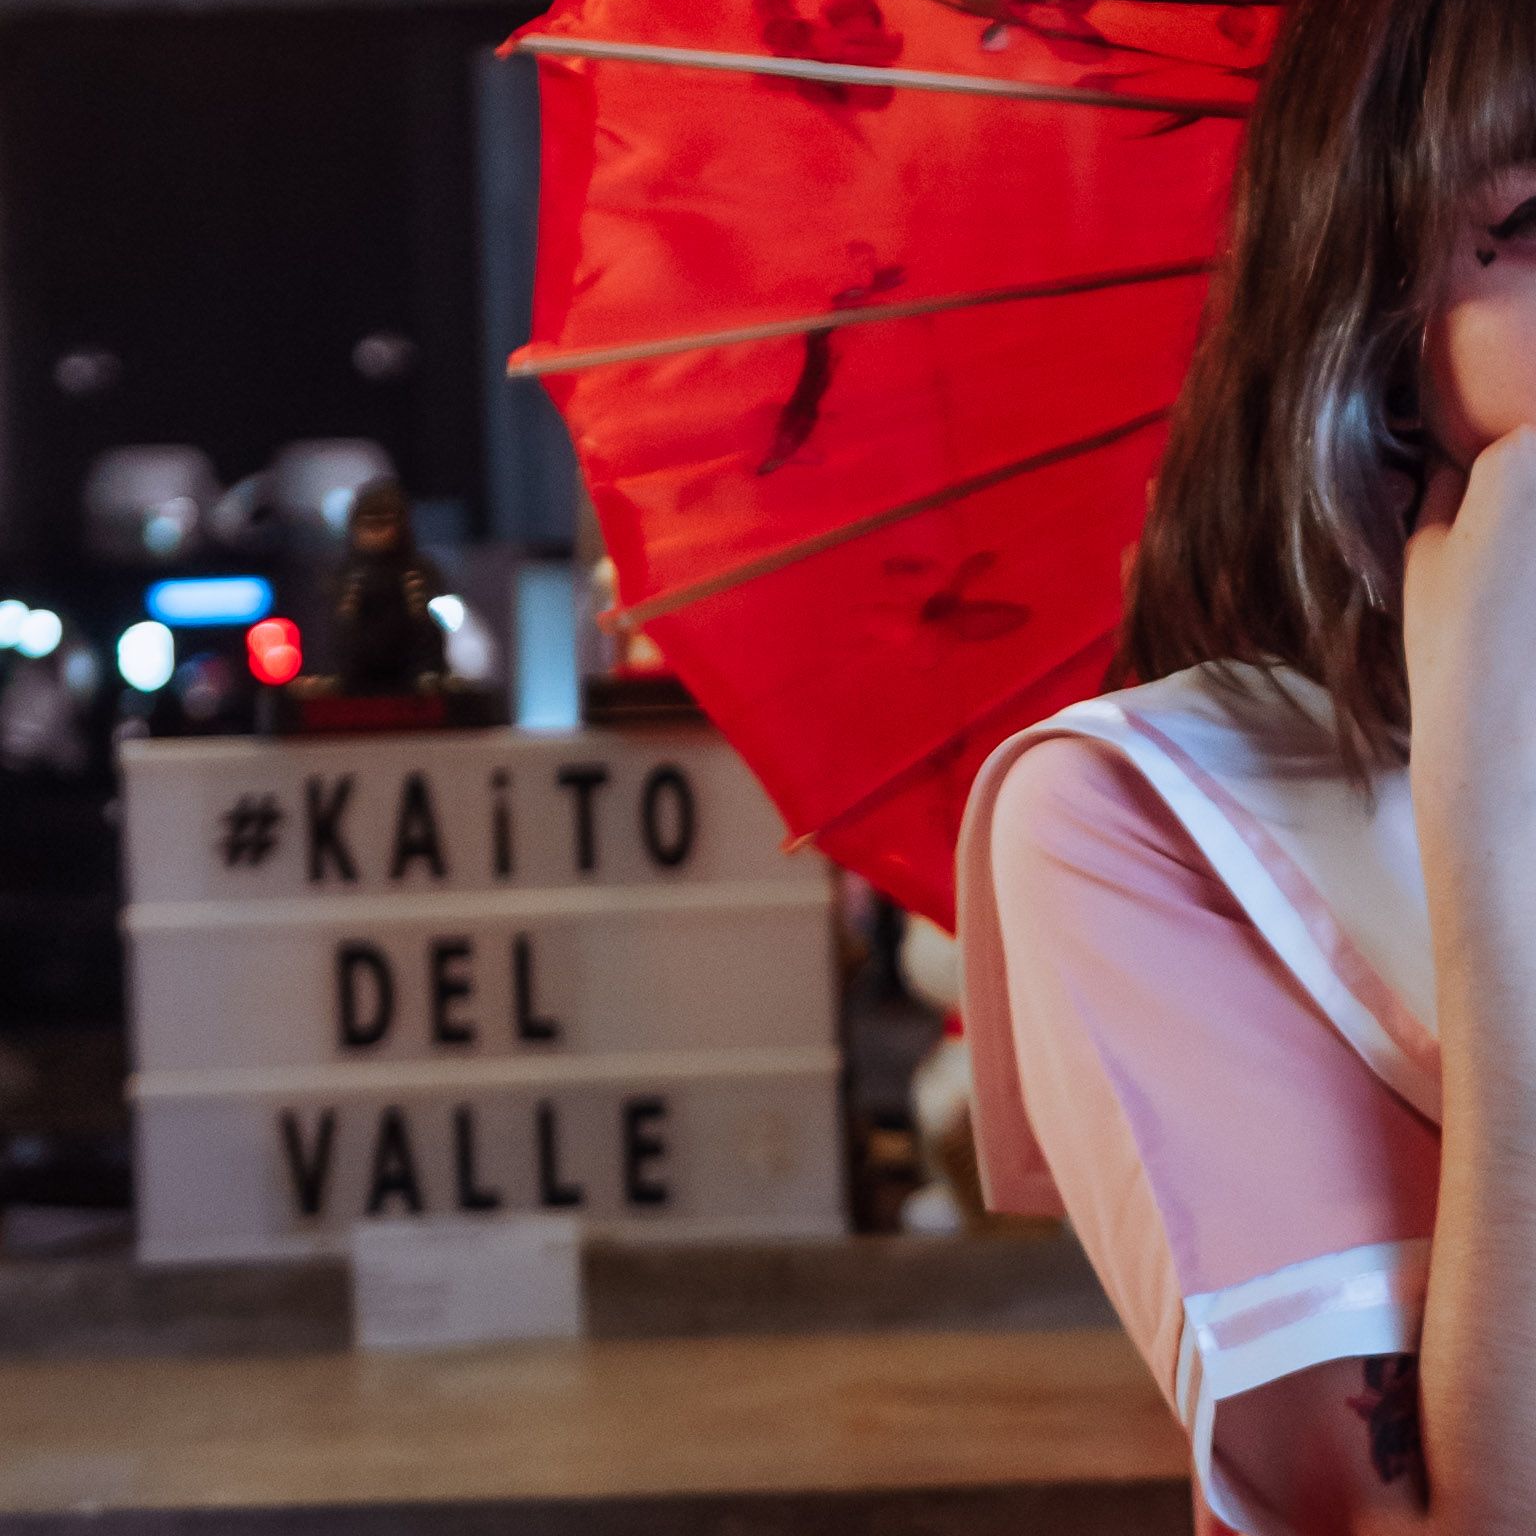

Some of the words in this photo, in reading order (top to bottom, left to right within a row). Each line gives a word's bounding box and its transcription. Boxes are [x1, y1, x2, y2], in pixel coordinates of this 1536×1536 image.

[220, 765, 696, 883] #KAiTO
[336, 932, 561, 1047] DEL
[281, 1099, 672, 1215] VALLE
